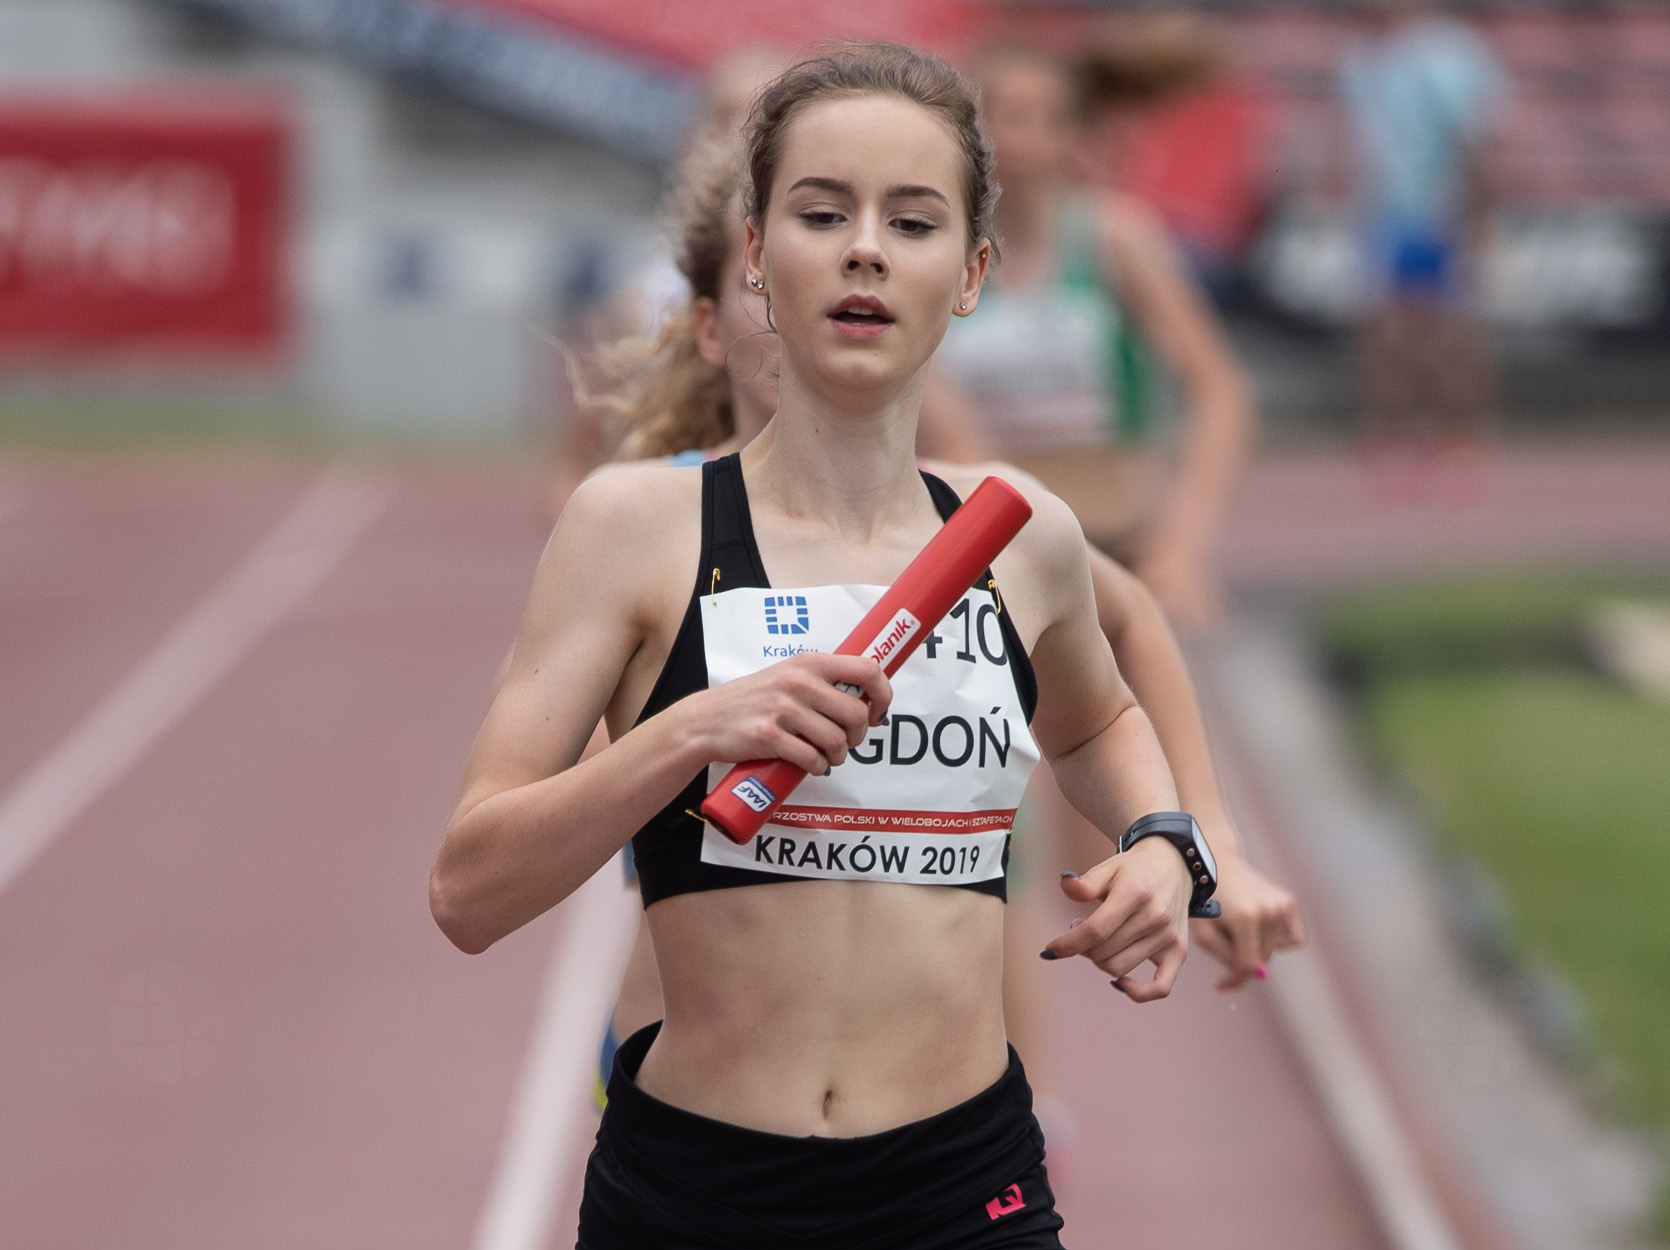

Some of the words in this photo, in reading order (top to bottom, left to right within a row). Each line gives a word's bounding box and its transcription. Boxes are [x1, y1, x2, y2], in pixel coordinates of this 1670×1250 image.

[762, 644, 819, 658] Krakó
[737, 785, 768, 808] IAAF
[834, 814, 875, 825] POLSKI
[877, 816, 889, 826] W
[891, 816, 969, 828] WIELOBOJACH
[754, 834, 910, 874] KRAKÓW
[919, 845, 980, 875] 2019
